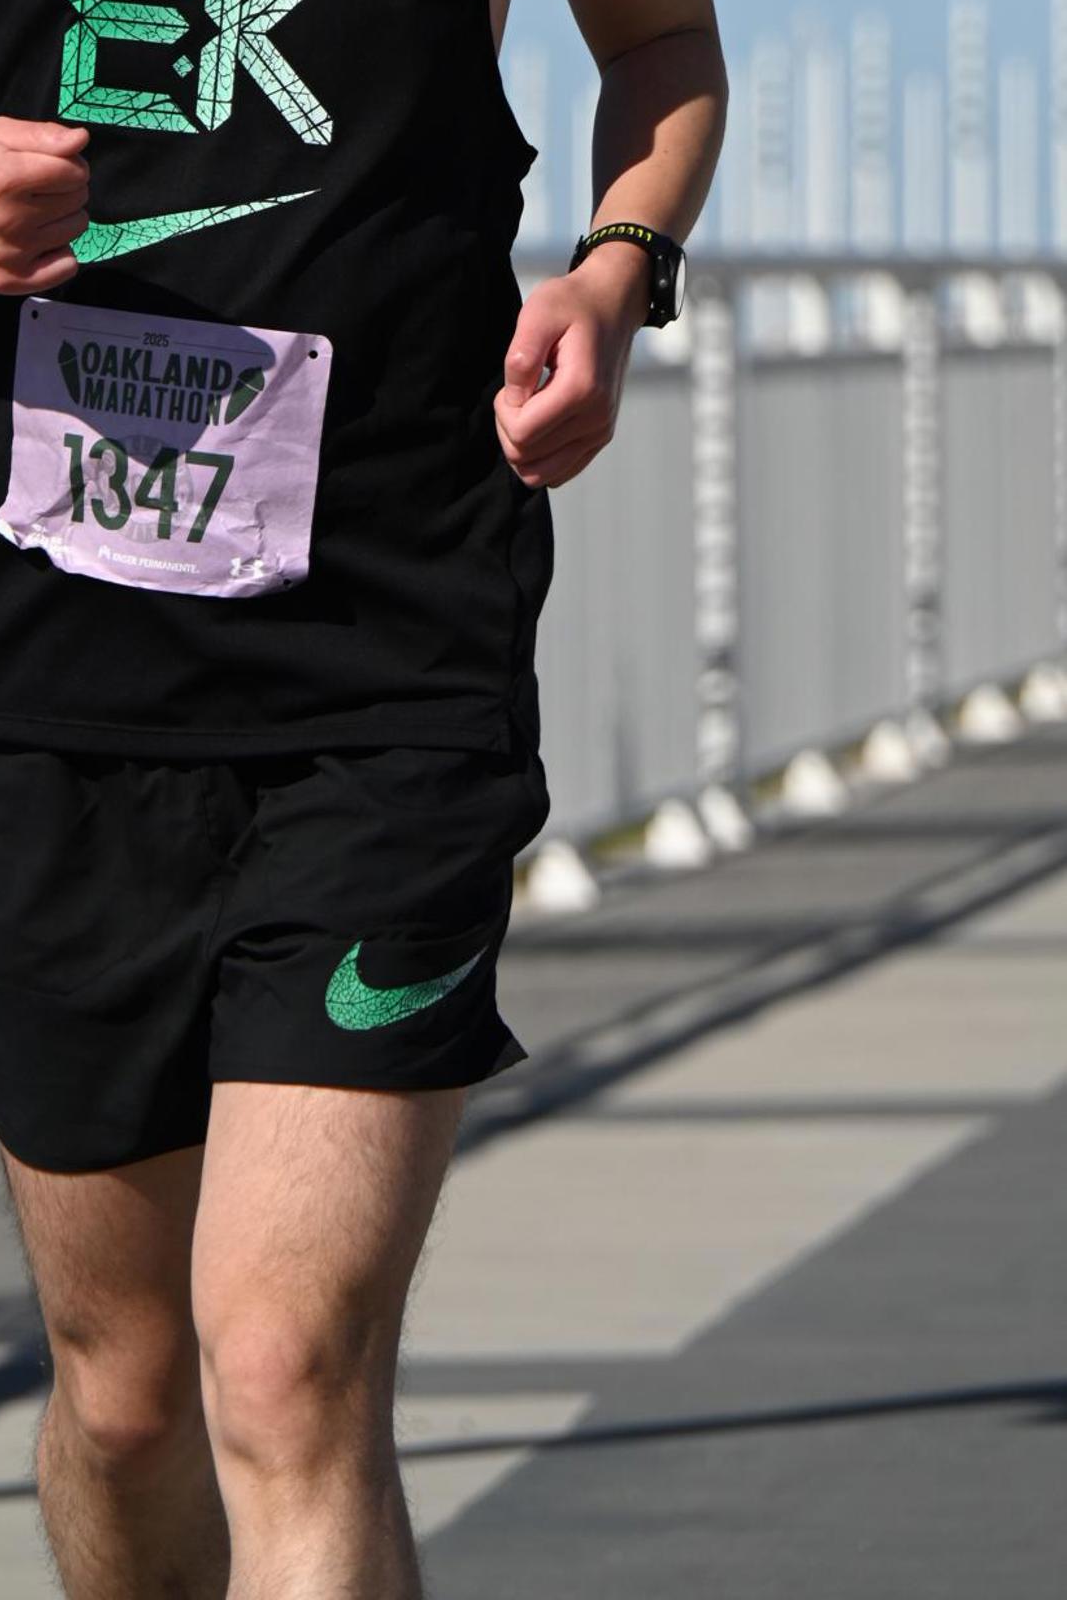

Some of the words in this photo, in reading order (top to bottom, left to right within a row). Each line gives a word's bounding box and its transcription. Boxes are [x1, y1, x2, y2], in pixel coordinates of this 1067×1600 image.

[143, 332, 171, 348] 2025
[82, 342, 232, 391] OAKLAND
[83, 377, 222, 426] MARATHON
[64, 433, 234, 543] 1347
